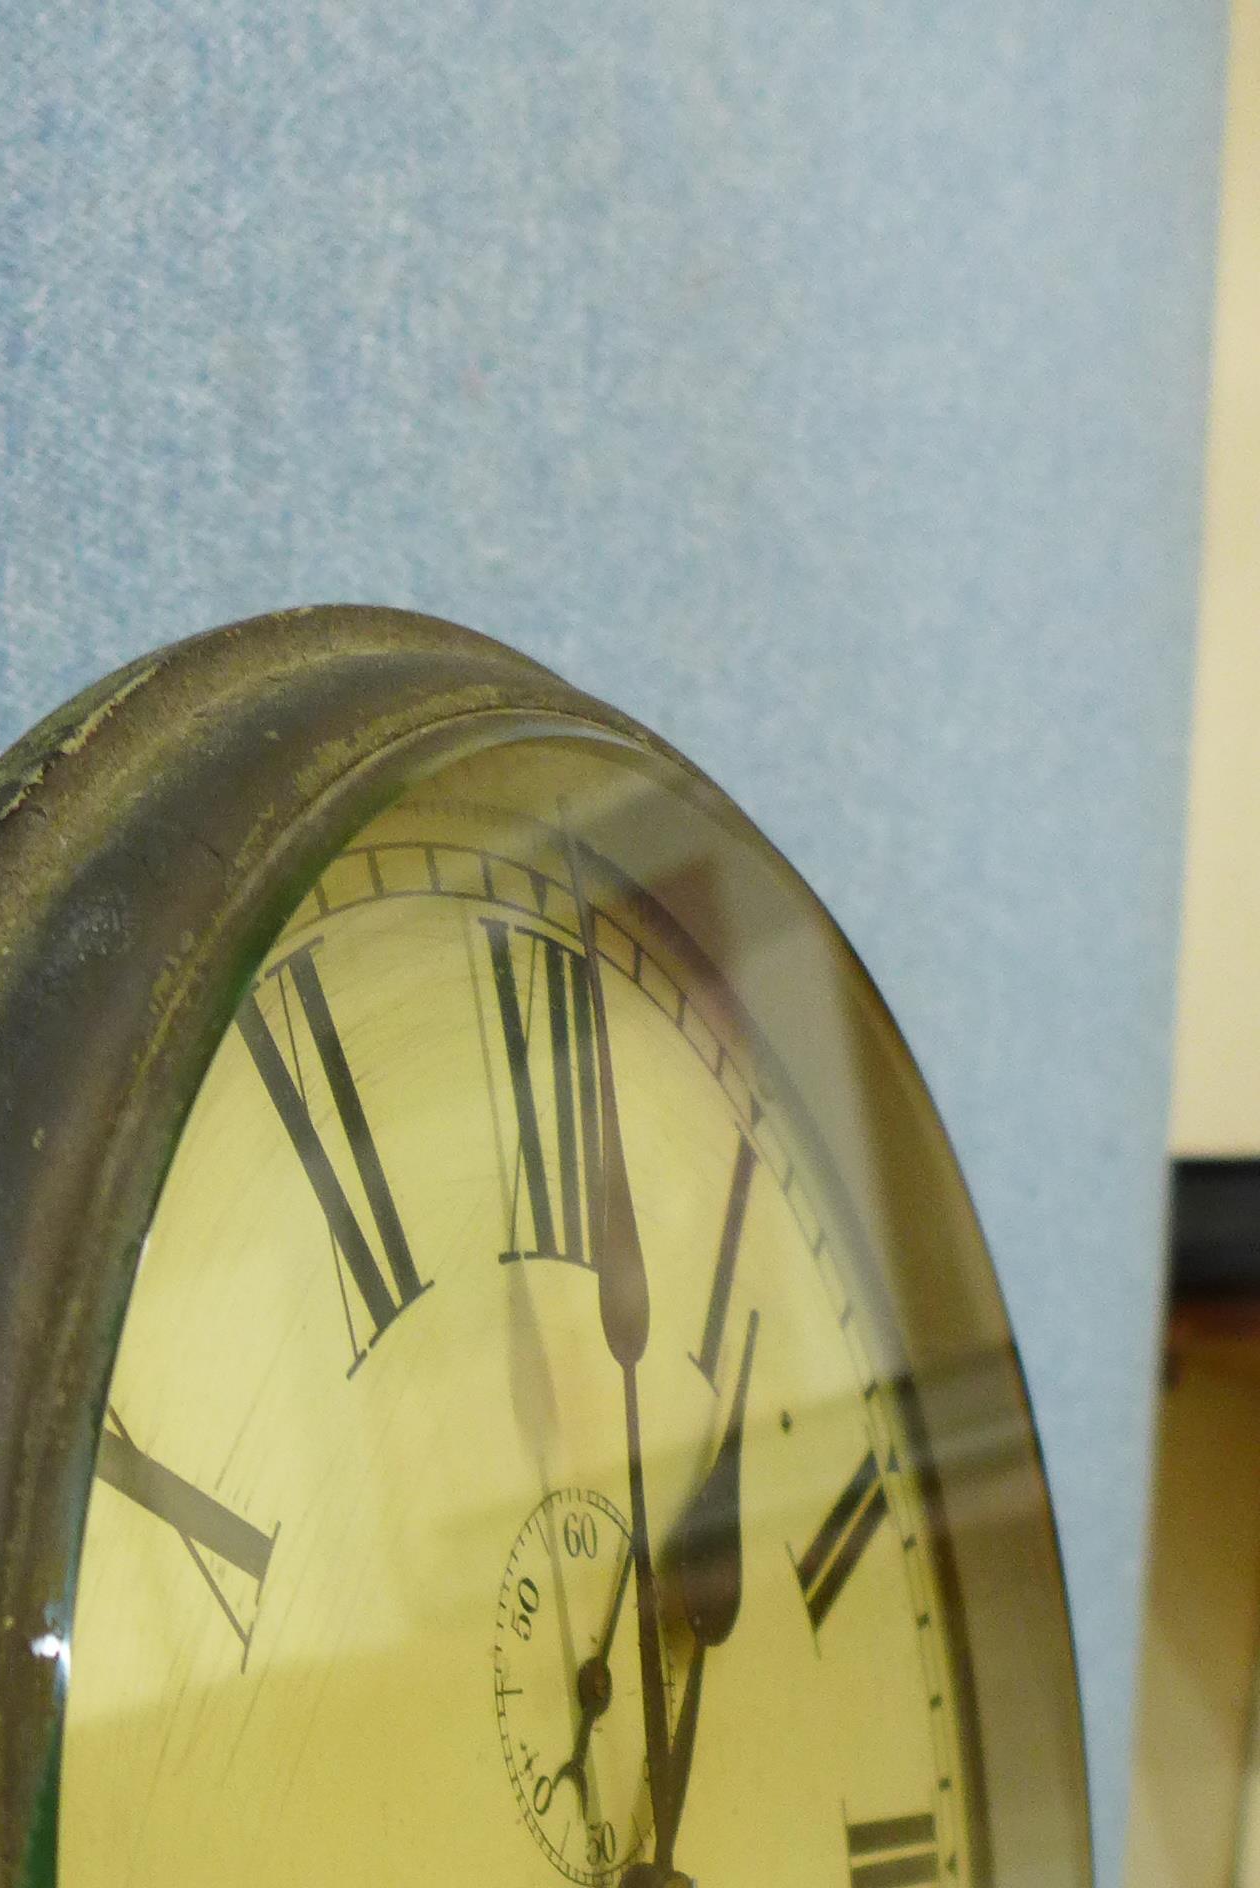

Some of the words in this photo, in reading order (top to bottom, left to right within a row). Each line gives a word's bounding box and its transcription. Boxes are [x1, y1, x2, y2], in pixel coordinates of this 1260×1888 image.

[235, 935, 435, 1381] XI
[562, 1512, 598, 1560] 60
[785, 1445, 893, 1660] II
[510, 1577, 541, 1641] 50
